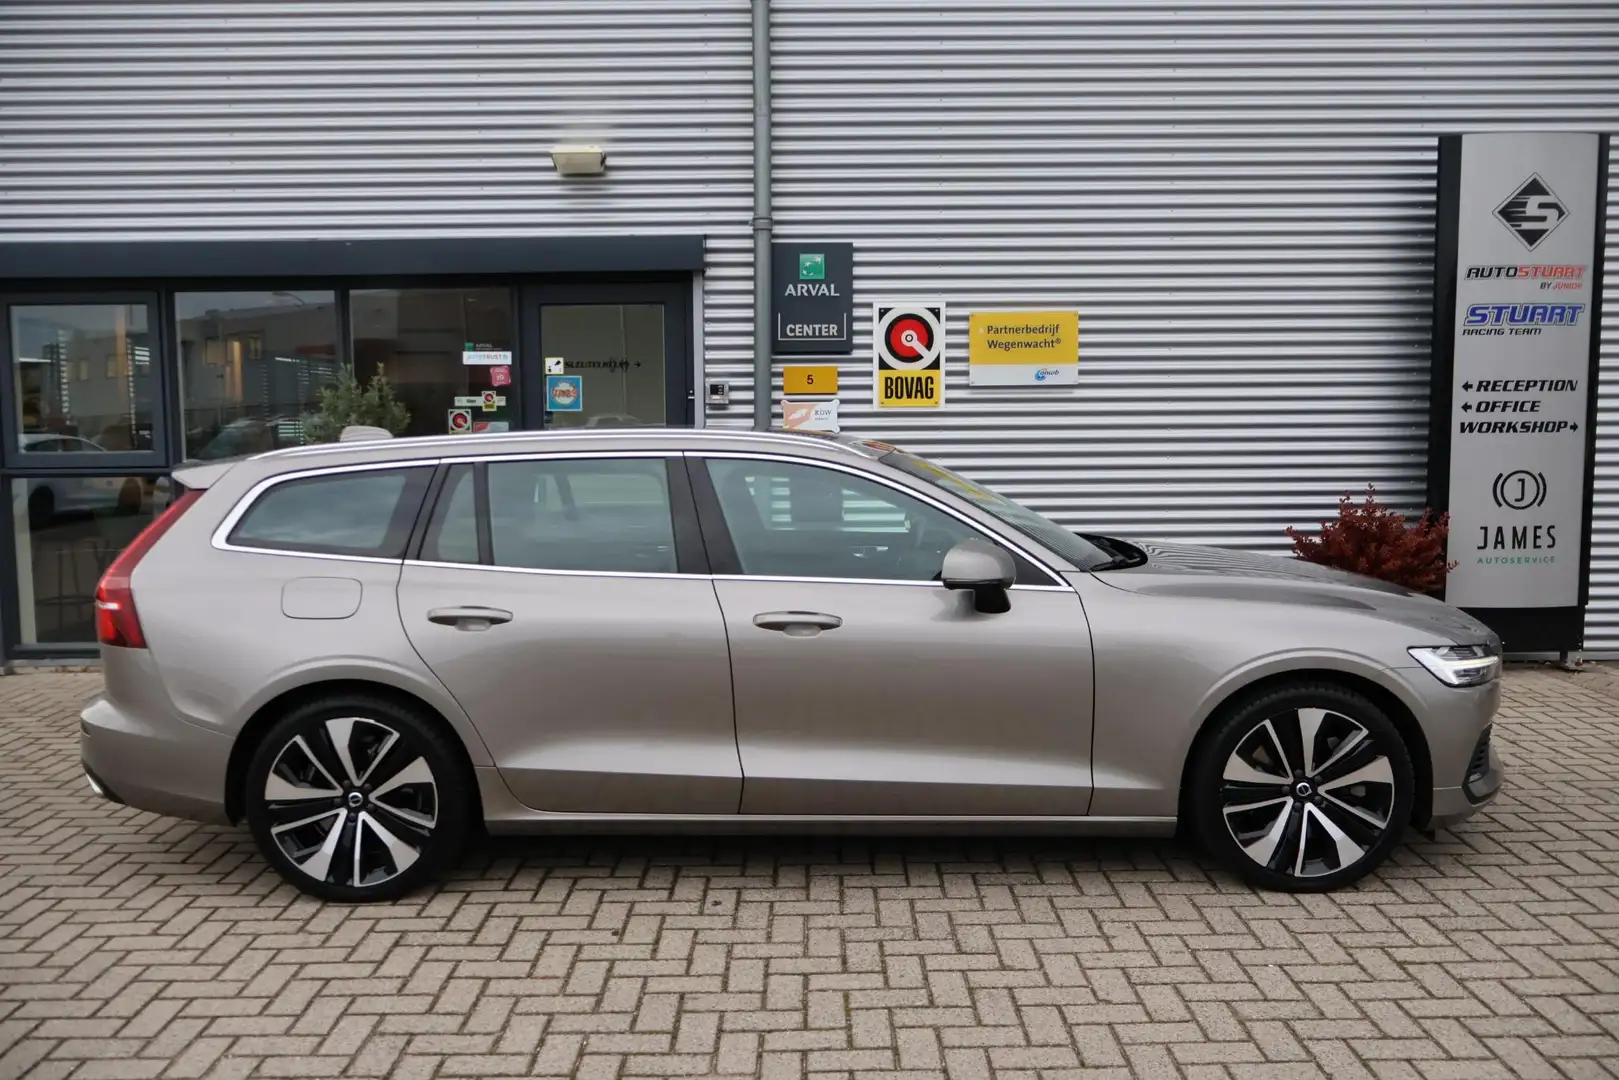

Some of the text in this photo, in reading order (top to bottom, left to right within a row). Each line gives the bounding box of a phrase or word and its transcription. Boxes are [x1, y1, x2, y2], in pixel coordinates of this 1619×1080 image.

[1466, 265, 1587, 279] AUTOSTUART
[785, 284, 840, 296] ARVAL
[1540, 282, 1583, 290] BY JUNIOR
[1463, 303, 1585, 326] STUART
[786, 324, 838, 336] CENTER
[987, 324, 1060, 335] Partnerbedrijf
[1462, 327, 1542, 336] RACING TEAM
[806, 374, 814, 385] 5
[1475, 379, 1578, 392] RECEPTION
[884, 376, 934, 399] BOVAG
[1475, 400, 1541, 413] OFFICE
[814, 409, 832, 417] RDW
[1459, 421, 1568, 434] WORKSHOP
[1476, 525, 1557, 550] JAMES
[1476, 556, 1556, 564] AUTOSERVICE
